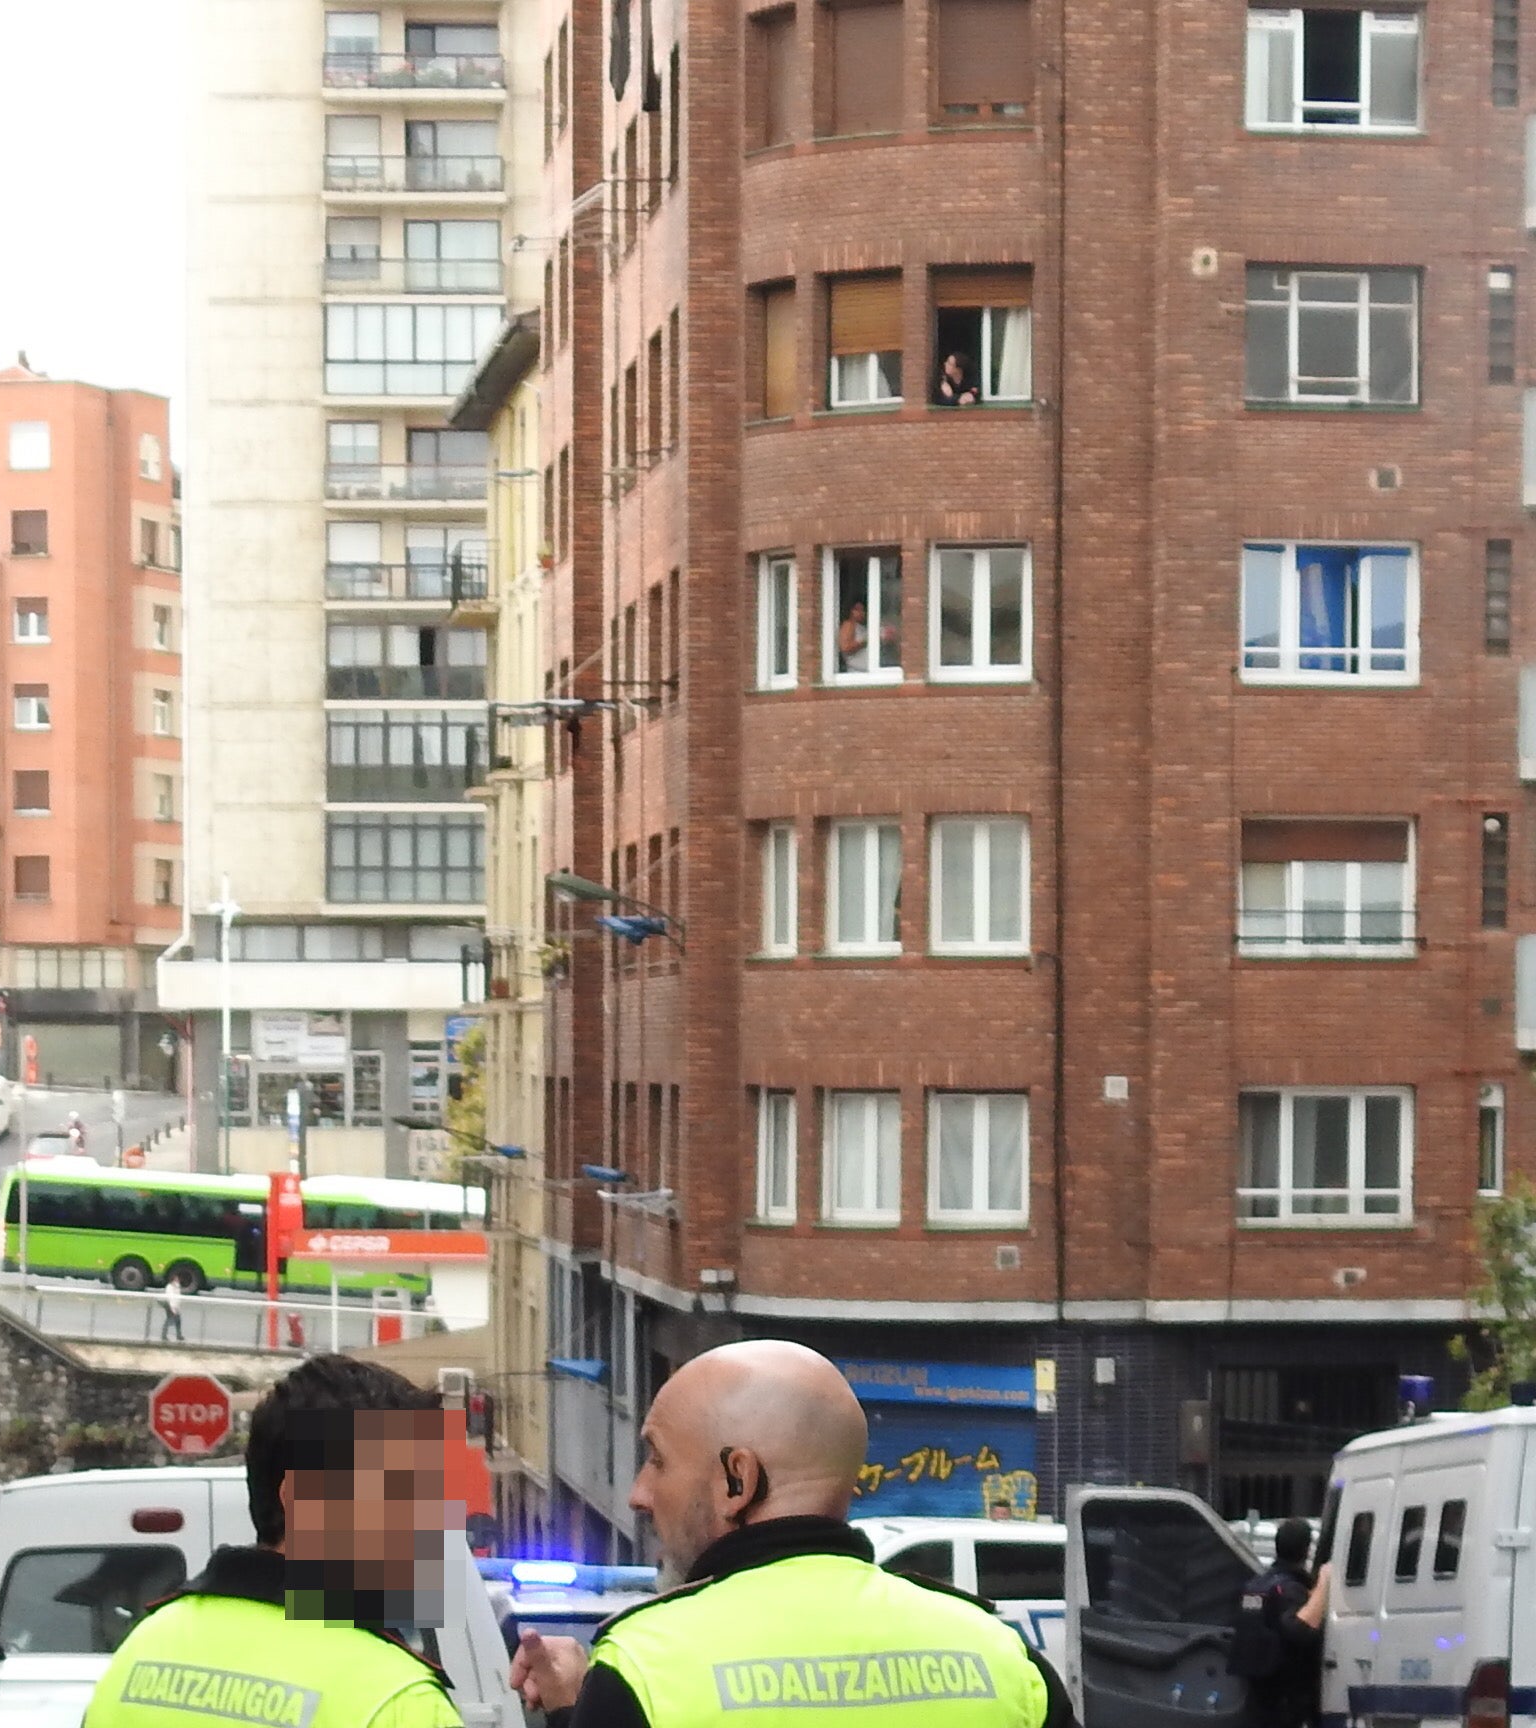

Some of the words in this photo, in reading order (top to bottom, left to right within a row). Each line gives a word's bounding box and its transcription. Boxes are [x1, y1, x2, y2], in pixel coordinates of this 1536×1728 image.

[159, 1402, 224, 1424] STOP
[127, 1664, 305, 1728] UDALTZAINGOA
[725, 1654, 988, 1704] UDALTZAINGOA
